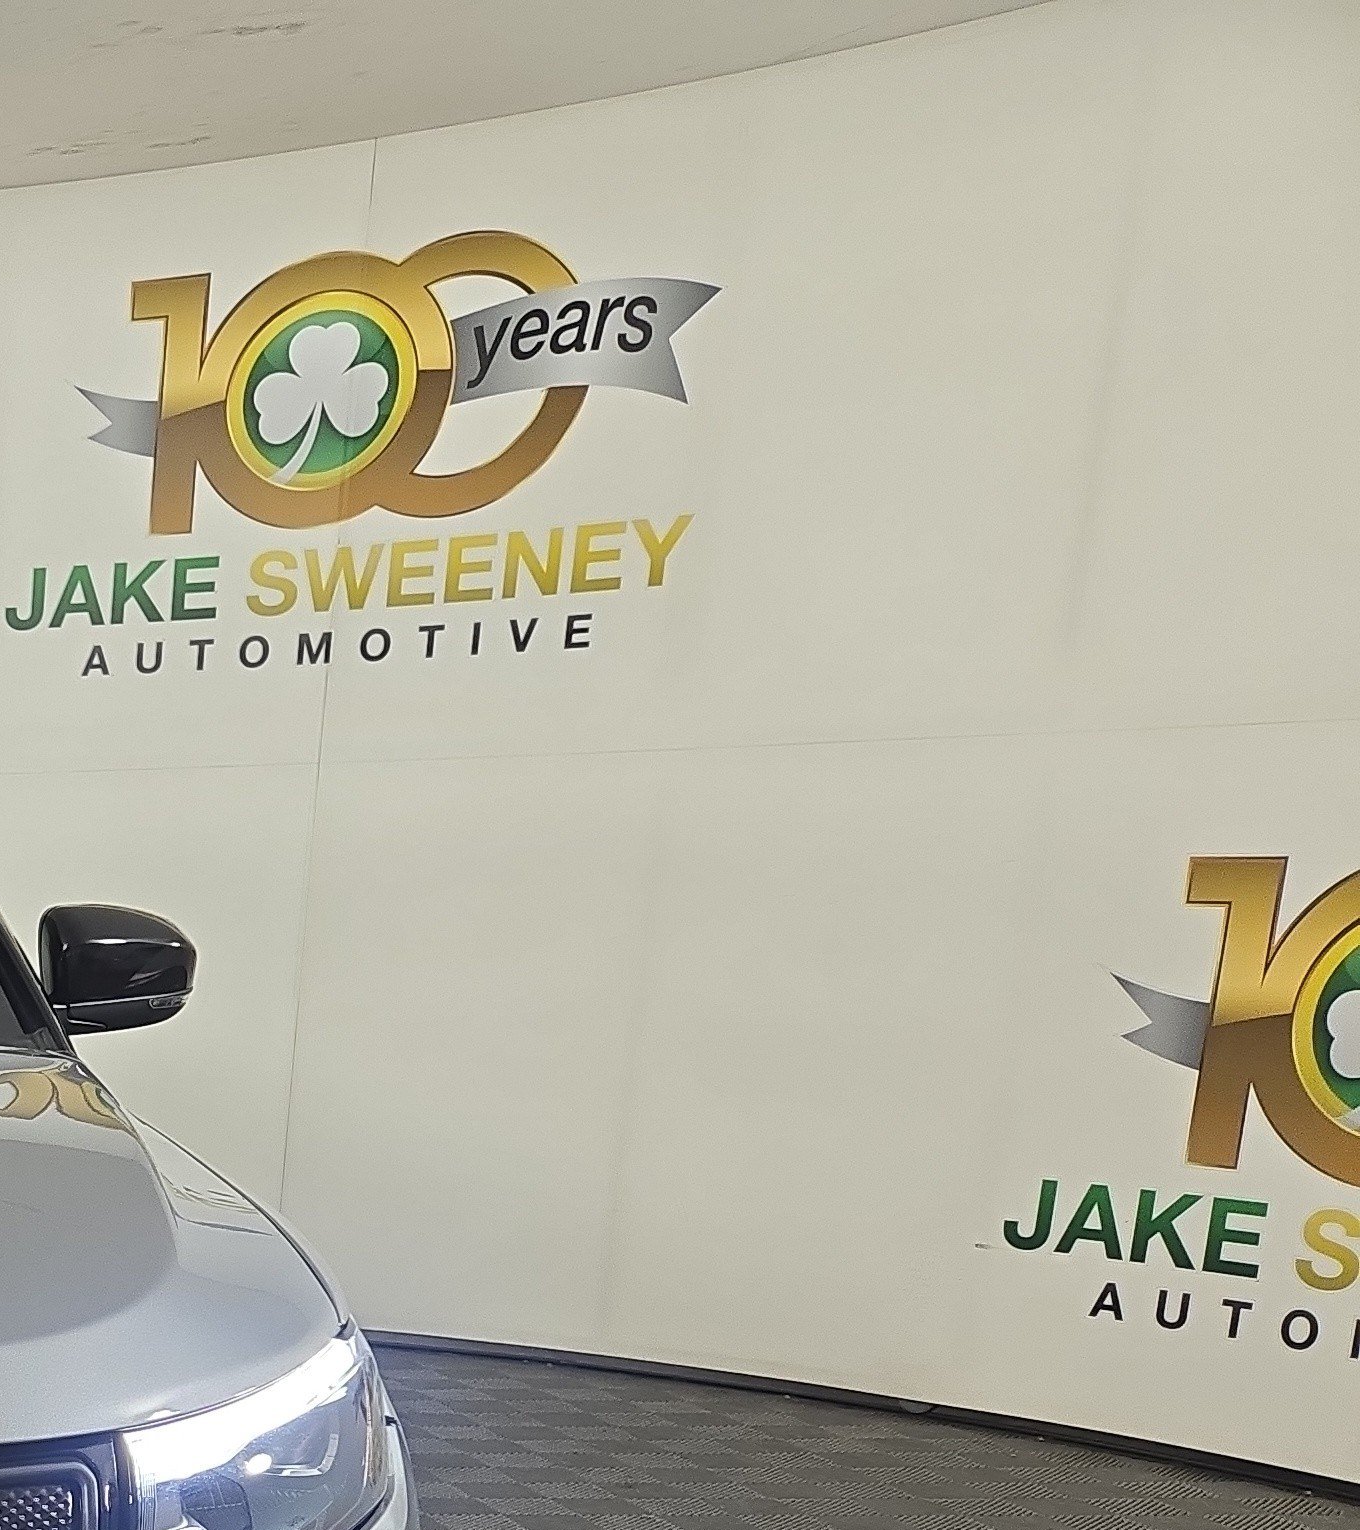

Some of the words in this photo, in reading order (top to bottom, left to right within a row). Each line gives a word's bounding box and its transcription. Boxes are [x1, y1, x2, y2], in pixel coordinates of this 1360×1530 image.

[466, 292, 659, 389] years
[4, 554, 221, 632] JAKE
[245, 513, 695, 618] SWEENEY
[81, 613, 594, 677] AUTOMOTIVE
[1002, 1178, 1269, 1280] JAKE
[1087, 1281, 1360, 1360] AUTO
